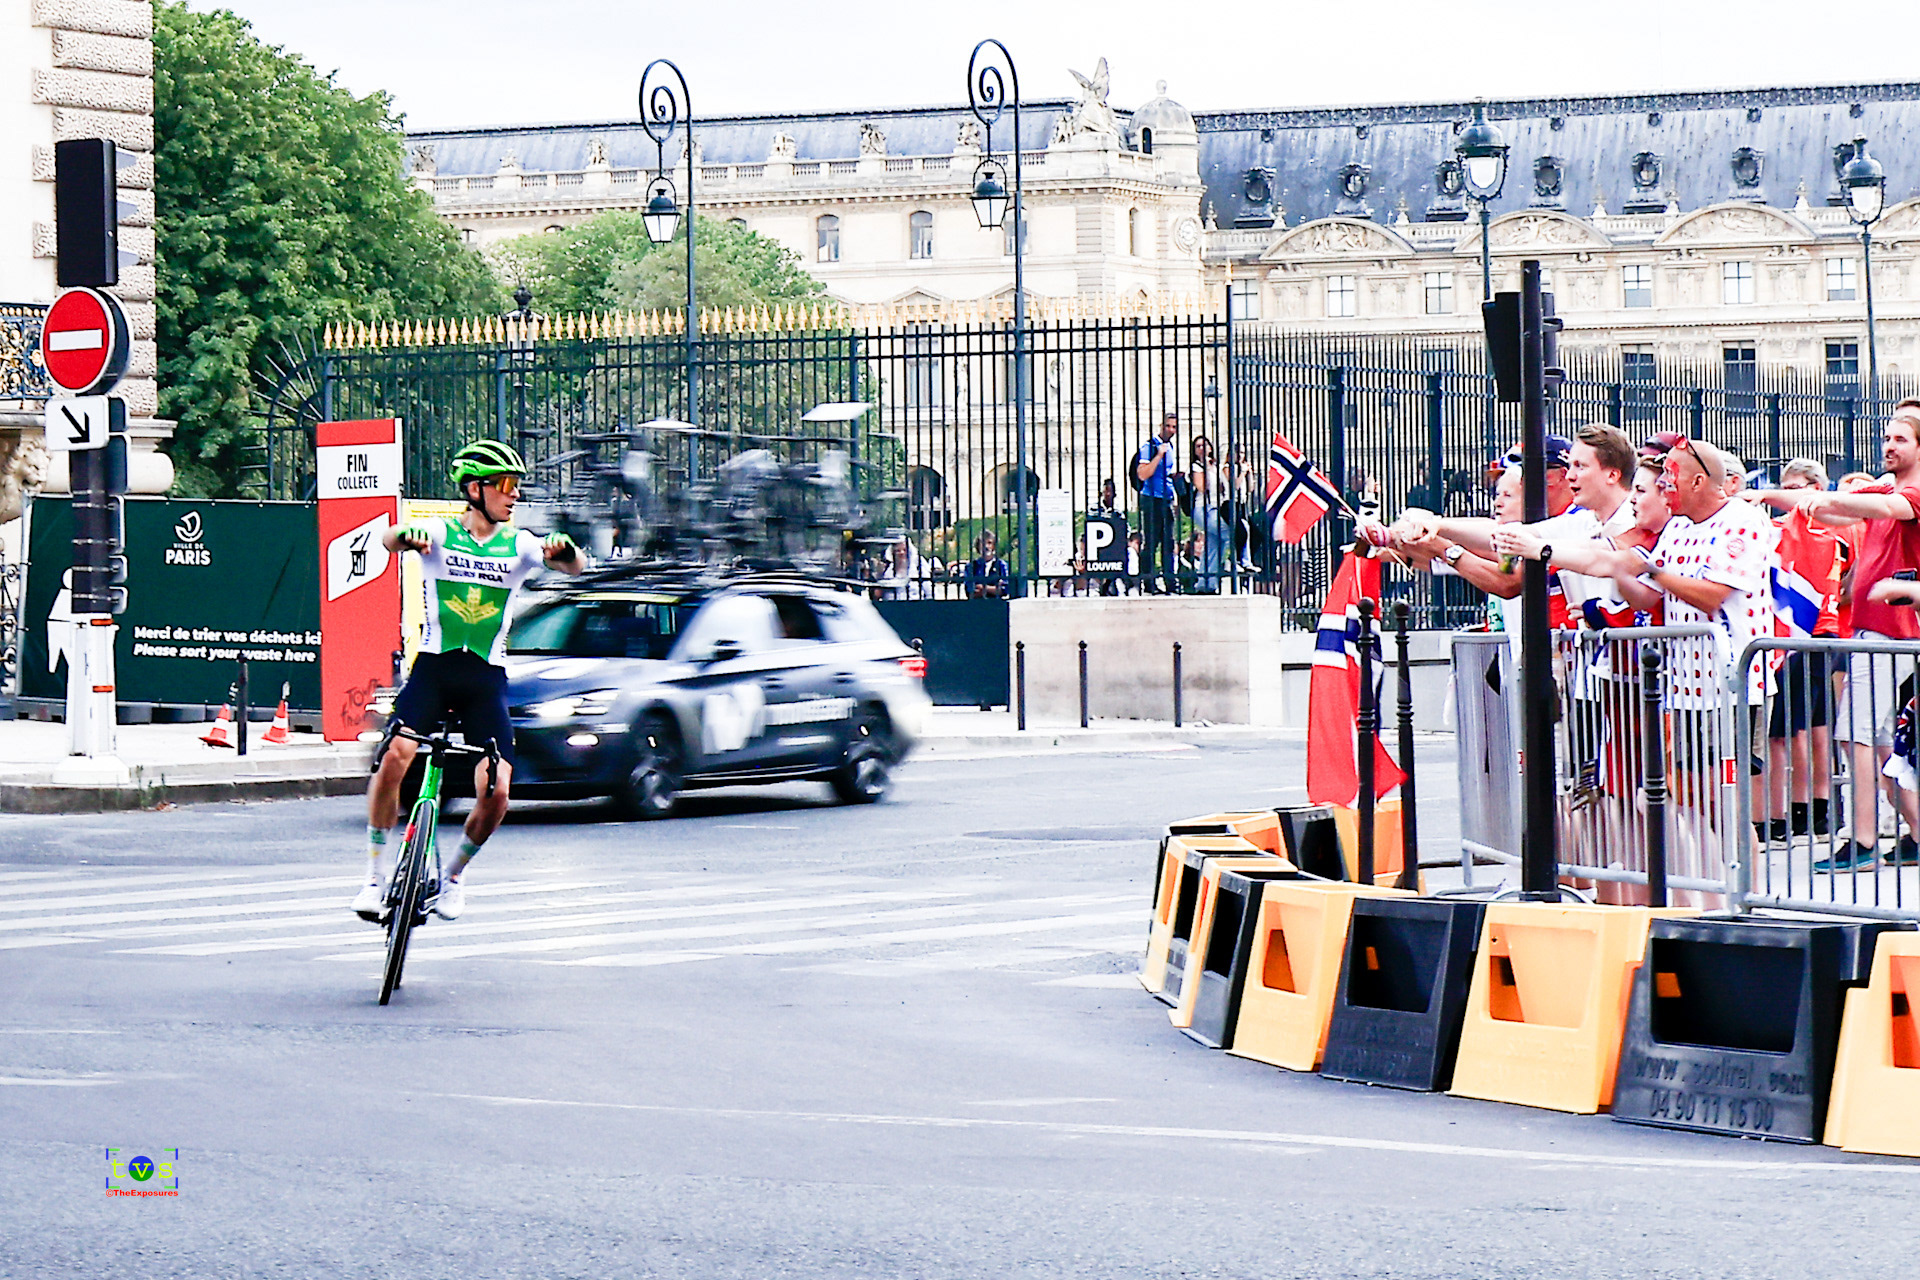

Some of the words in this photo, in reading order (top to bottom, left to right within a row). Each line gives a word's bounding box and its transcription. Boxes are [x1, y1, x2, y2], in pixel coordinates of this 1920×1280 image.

[347, 454, 368, 472] FIN
[337, 475, 379, 490] COLLECTE
[1086, 521, 1114, 561] P
[165, 549, 211, 565] PARIS
[1086, 561, 1123, 571] LOUVRE
[134, 626, 171, 640] Merci
[173, 627, 190, 641] de
[192, 627, 222, 641] trier
[223, 631, 247, 642] vos
[249, 630, 303, 645] déchets
[305, 631, 322, 646] ici
[133, 643, 178, 658] Please
[179, 646, 207, 658] sort
[207, 649, 240, 661] your
[242, 649, 283, 661] waste
[284, 648, 316, 662] here
